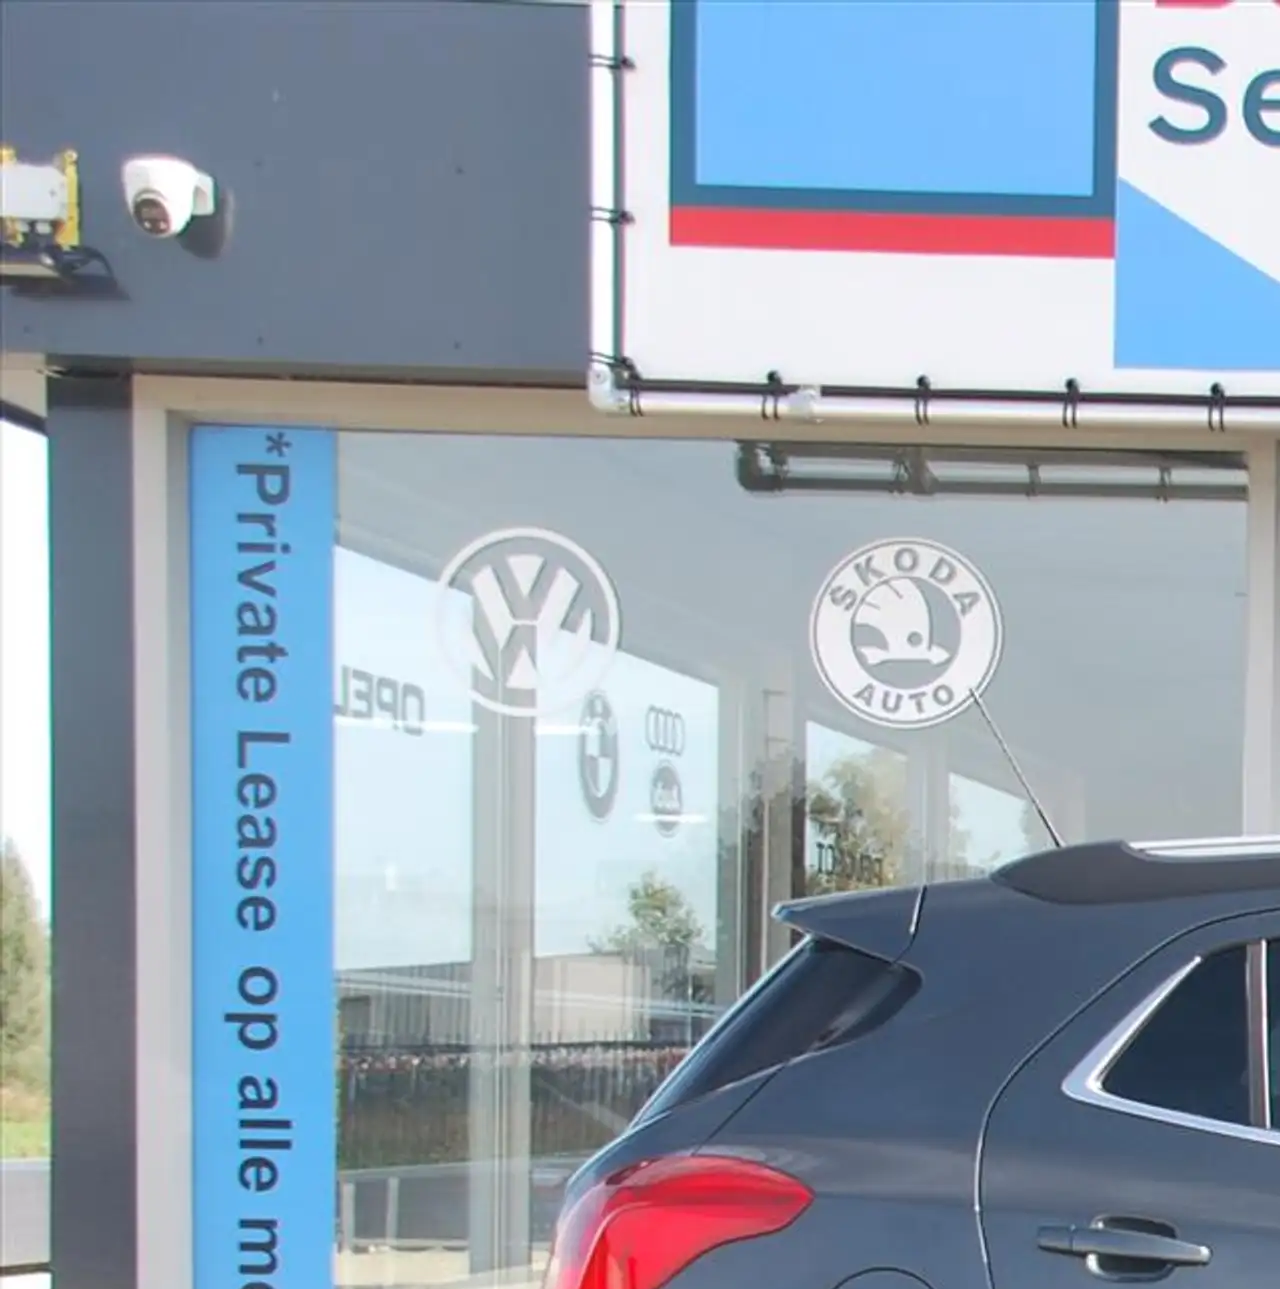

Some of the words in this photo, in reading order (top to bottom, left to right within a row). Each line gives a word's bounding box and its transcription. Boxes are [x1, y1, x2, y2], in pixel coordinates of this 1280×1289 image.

[829, 547, 982, 617] SKODA
[853, 683, 955, 714] AUTO
[235, 731, 291, 932] Lease
[224, 966, 279, 1051] op
[237, 1075, 293, 1194] alle
